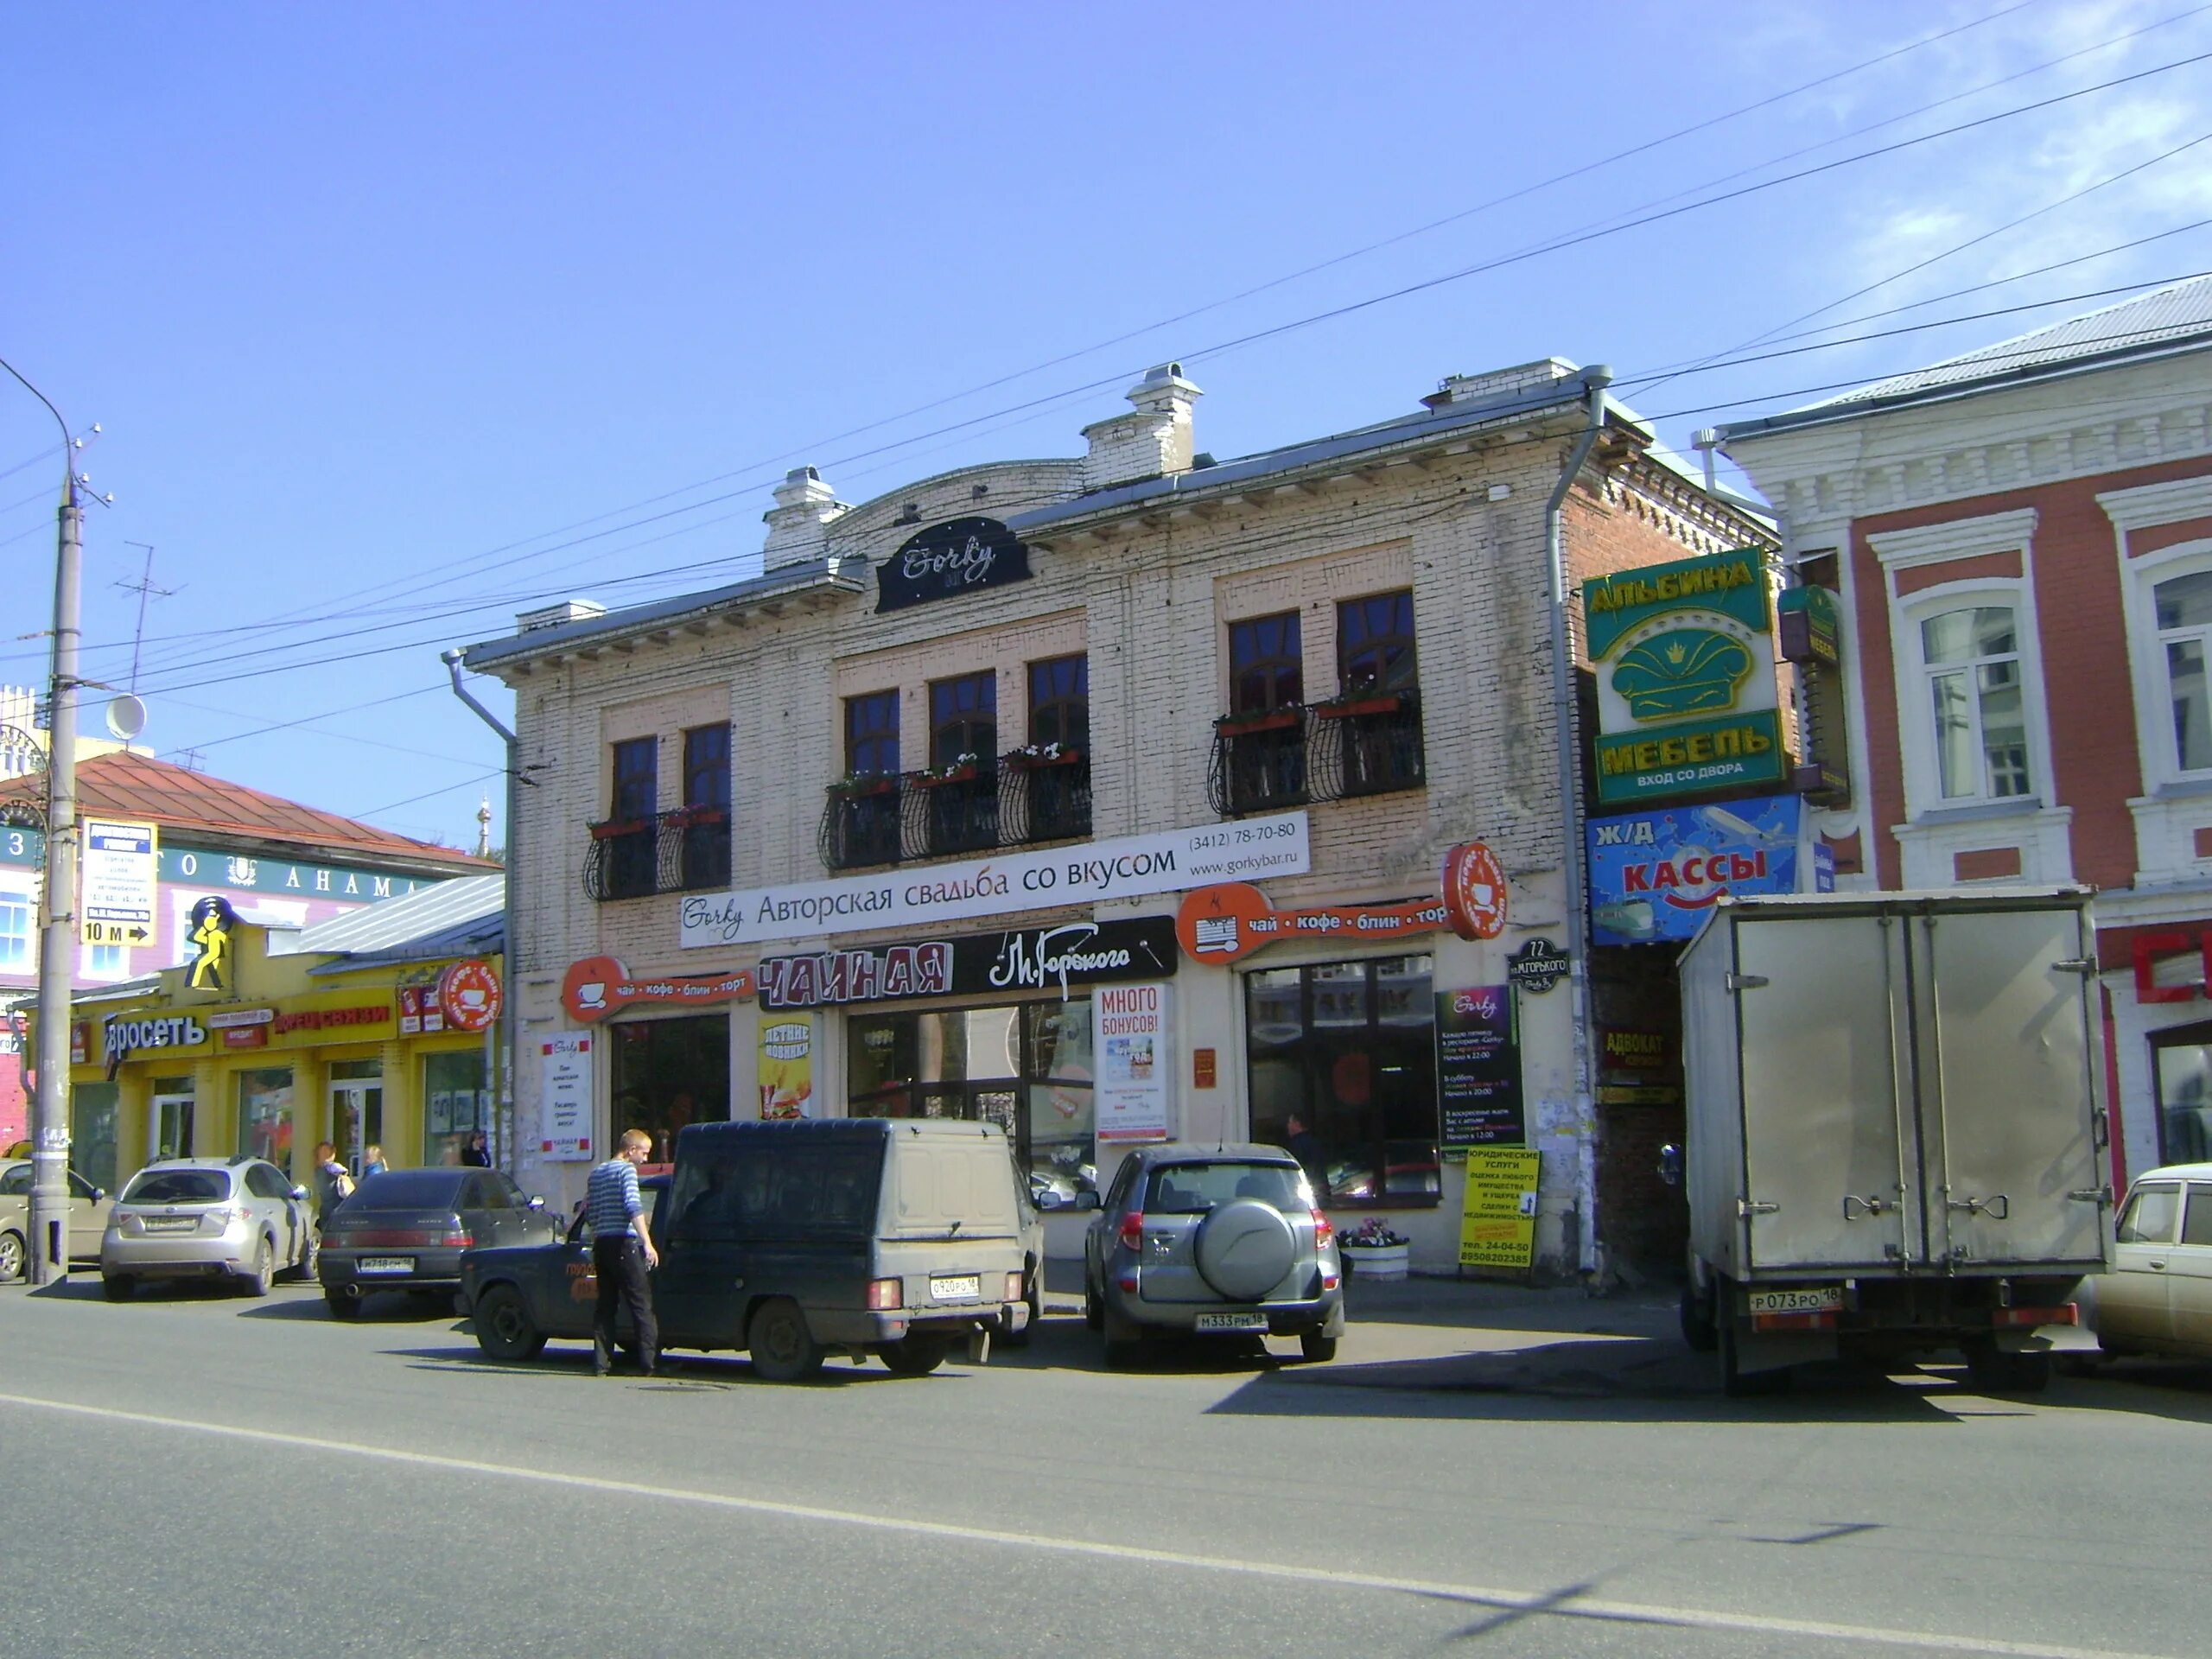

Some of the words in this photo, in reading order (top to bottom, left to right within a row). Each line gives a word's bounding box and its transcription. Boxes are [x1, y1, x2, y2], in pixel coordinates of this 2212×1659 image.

[903, 536, 996, 584] Gorky
[1590, 561, 1754, 613] АЛЬБИНА
[1600, 726, 1770, 775] МЕБЕЛЬ
[1637, 772, 1674, 787] ВХОД
[1676, 768, 1694, 781] СО
[1699, 762, 1744, 780] ДВОРА
[1189, 833, 1230, 852] (3412)
[1235, 823, 1295, 844] 78-70-80
[1596, 822, 1655, 847] Ж/Д
[1190, 852, 1297, 876] www.gorkybar.ru
[1623, 850, 1766, 893] КАССЫ
[758, 887, 892, 925] Авторская
[905, 865, 1009, 906] свадьба
[683, 897, 744, 940] Gorky
[1249, 916, 1277, 931] чай
[1297, 912, 1340, 932] кофе
[1357, 912, 1400, 930] блин
[1415, 906, 1447, 924] тор
[86, 923, 102, 941] 10
[759, 942, 953, 1006] ЧАЙНАЯ
[617, 984, 635, 995] чай
[646, 982, 673, 997] кофе
[683, 983, 710, 996] блин
[721, 977, 746, 992] торт
[1102, 988, 1157, 1014] МНОГО
[1453, 995, 1497, 1019] Gorky
[765, 1023, 810, 1043] ЛЕТНИЕ
[1103, 1015, 1158, 1035] БОНУСОВ!
[766, 1041, 809, 1059] НОВИНКИ
[1606, 1032, 1663, 1055] АДВОКАТ
[1469, 1149, 1538, 1160] ЮРИДИЧЕСКИЕ
[1485, 1160, 1519, 1169] УСЛУГИ
[1478, 1182, 1524, 1191] ИМУЩЕСТВА
[1486, 1241, 1529, 1252] 24-04-50
[933, 1280, 966, 1294] О920РО
[1756, 1294, 1819, 1309] Р073РО
[1823, 1288, 1838, 1300] 18
[1202, 1315, 1249, 1327] М333РМ
